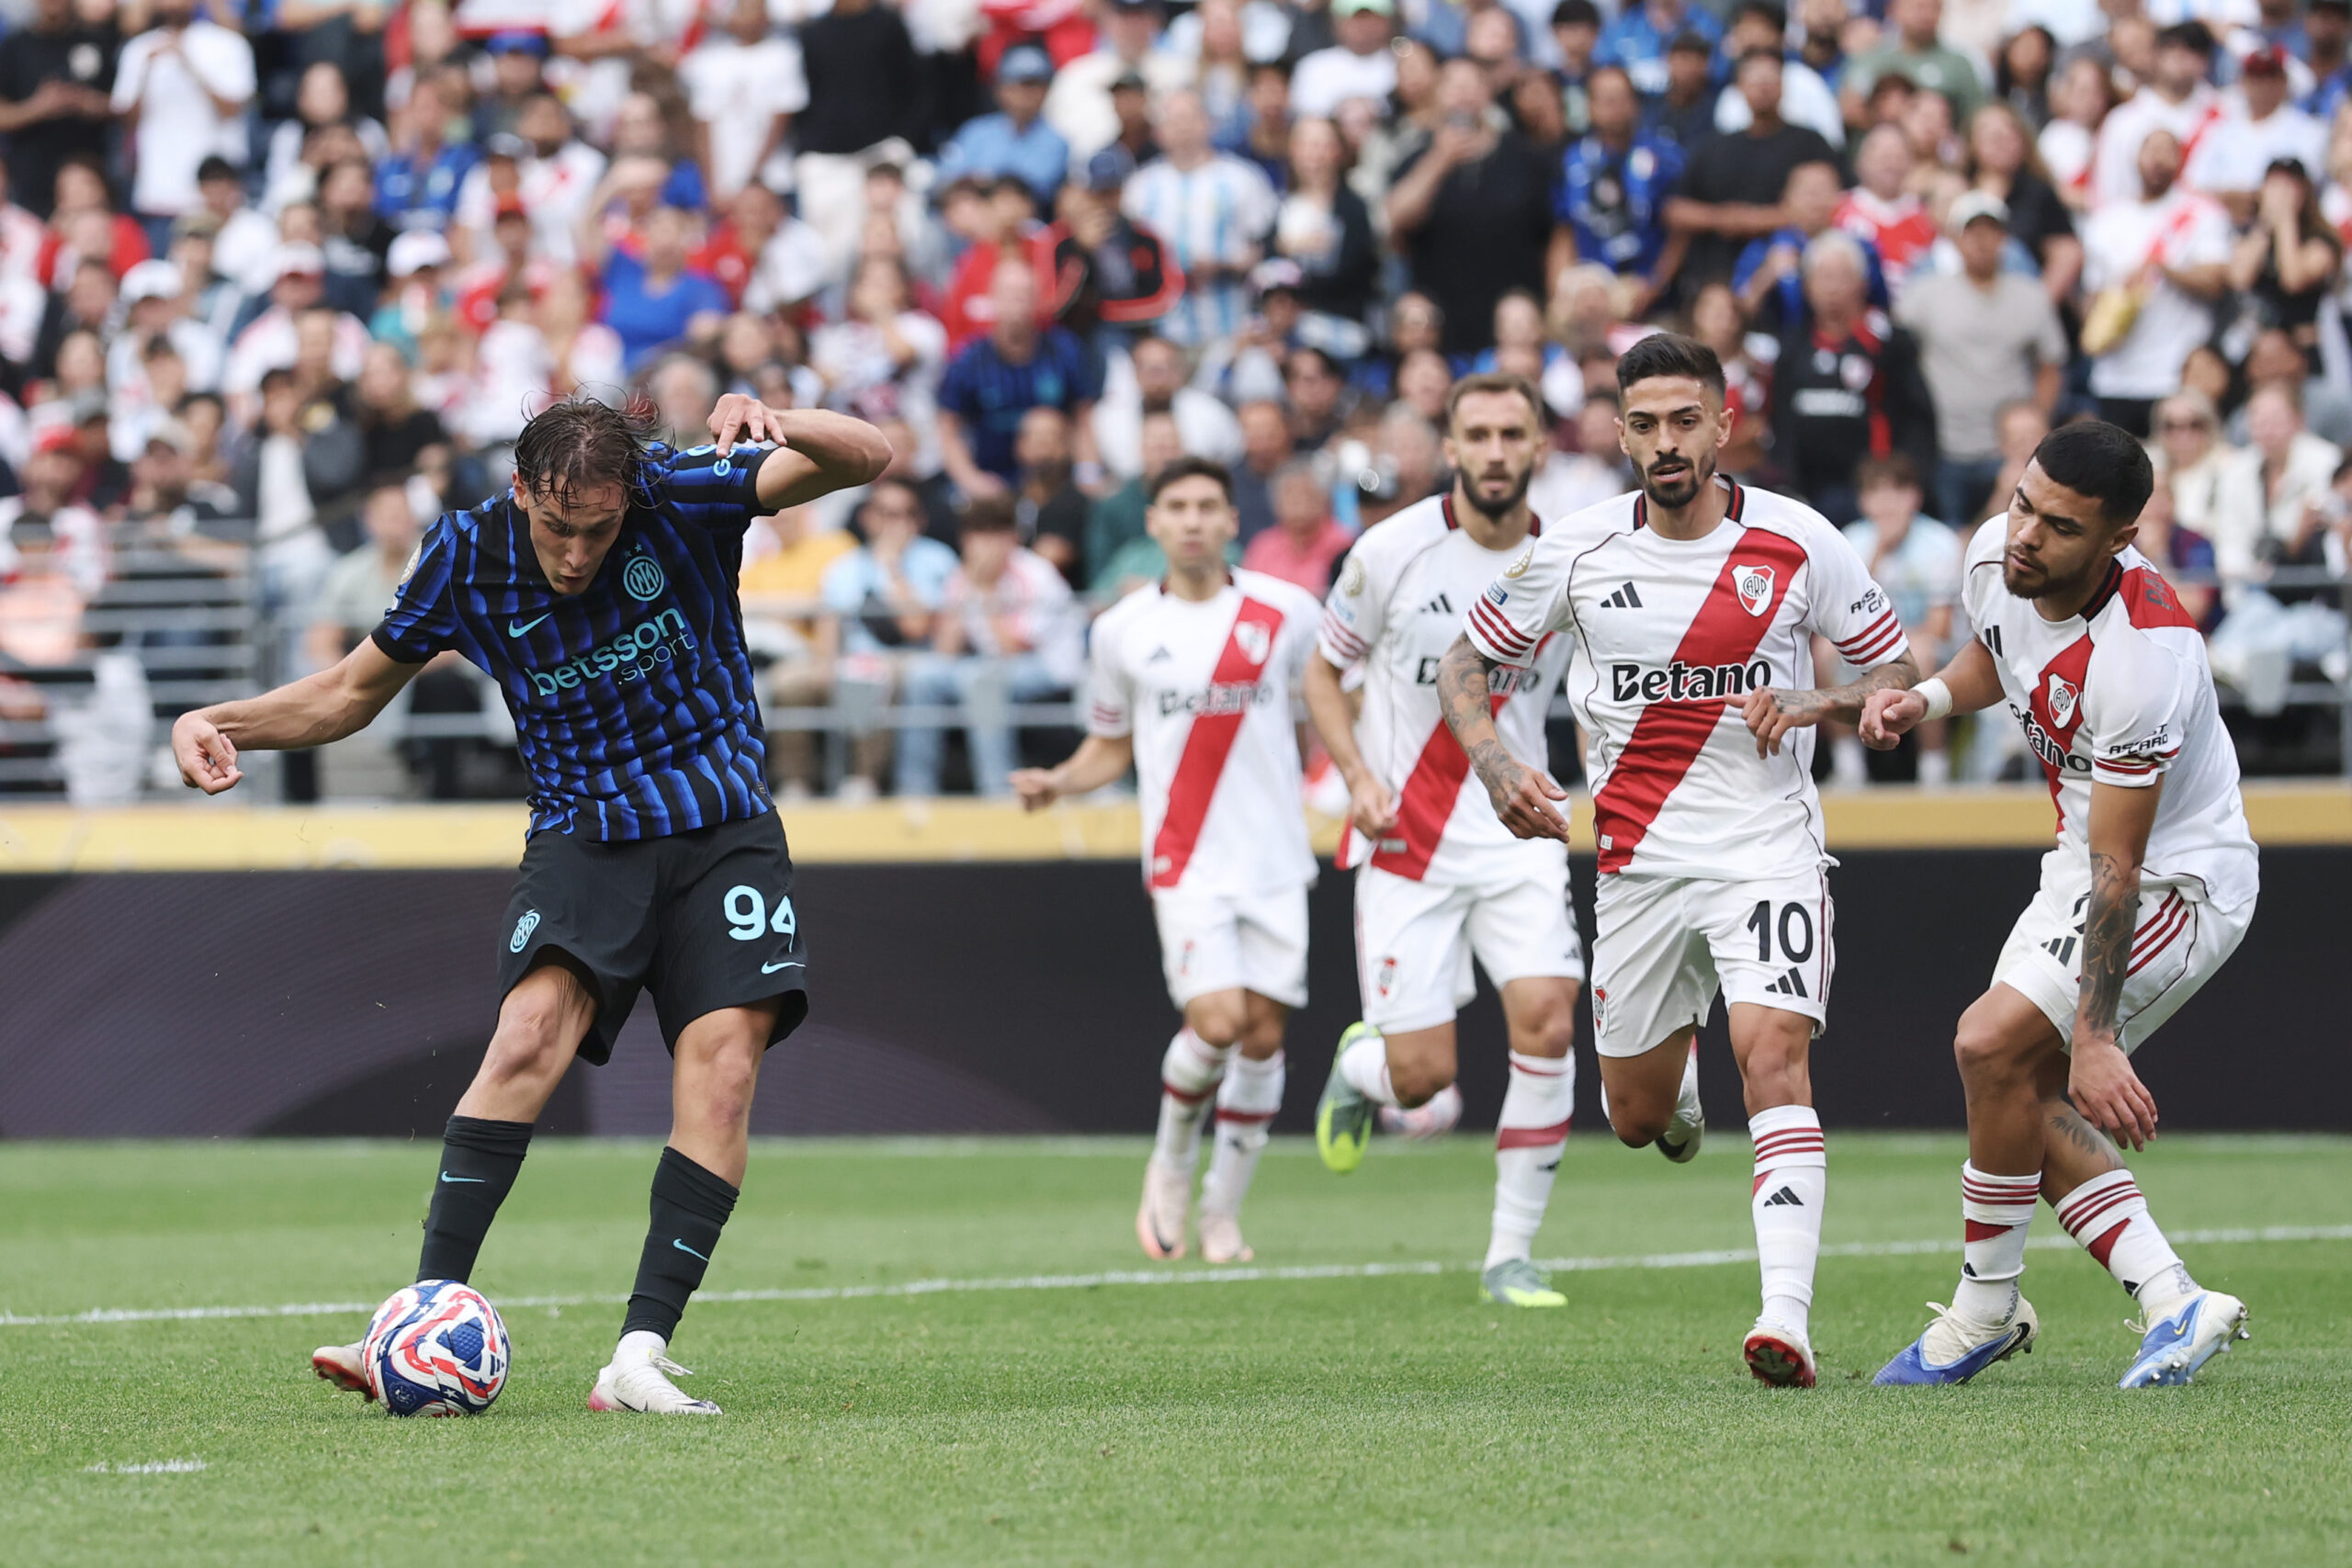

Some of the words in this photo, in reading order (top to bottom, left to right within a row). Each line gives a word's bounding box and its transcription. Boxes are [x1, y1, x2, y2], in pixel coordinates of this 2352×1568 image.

[525, 607, 685, 696] betsson
[1612, 660, 1771, 702] Betano
[2008, 703, 2092, 772] etano
[723, 885, 796, 953] 94
[1747, 900, 1814, 964] 10
